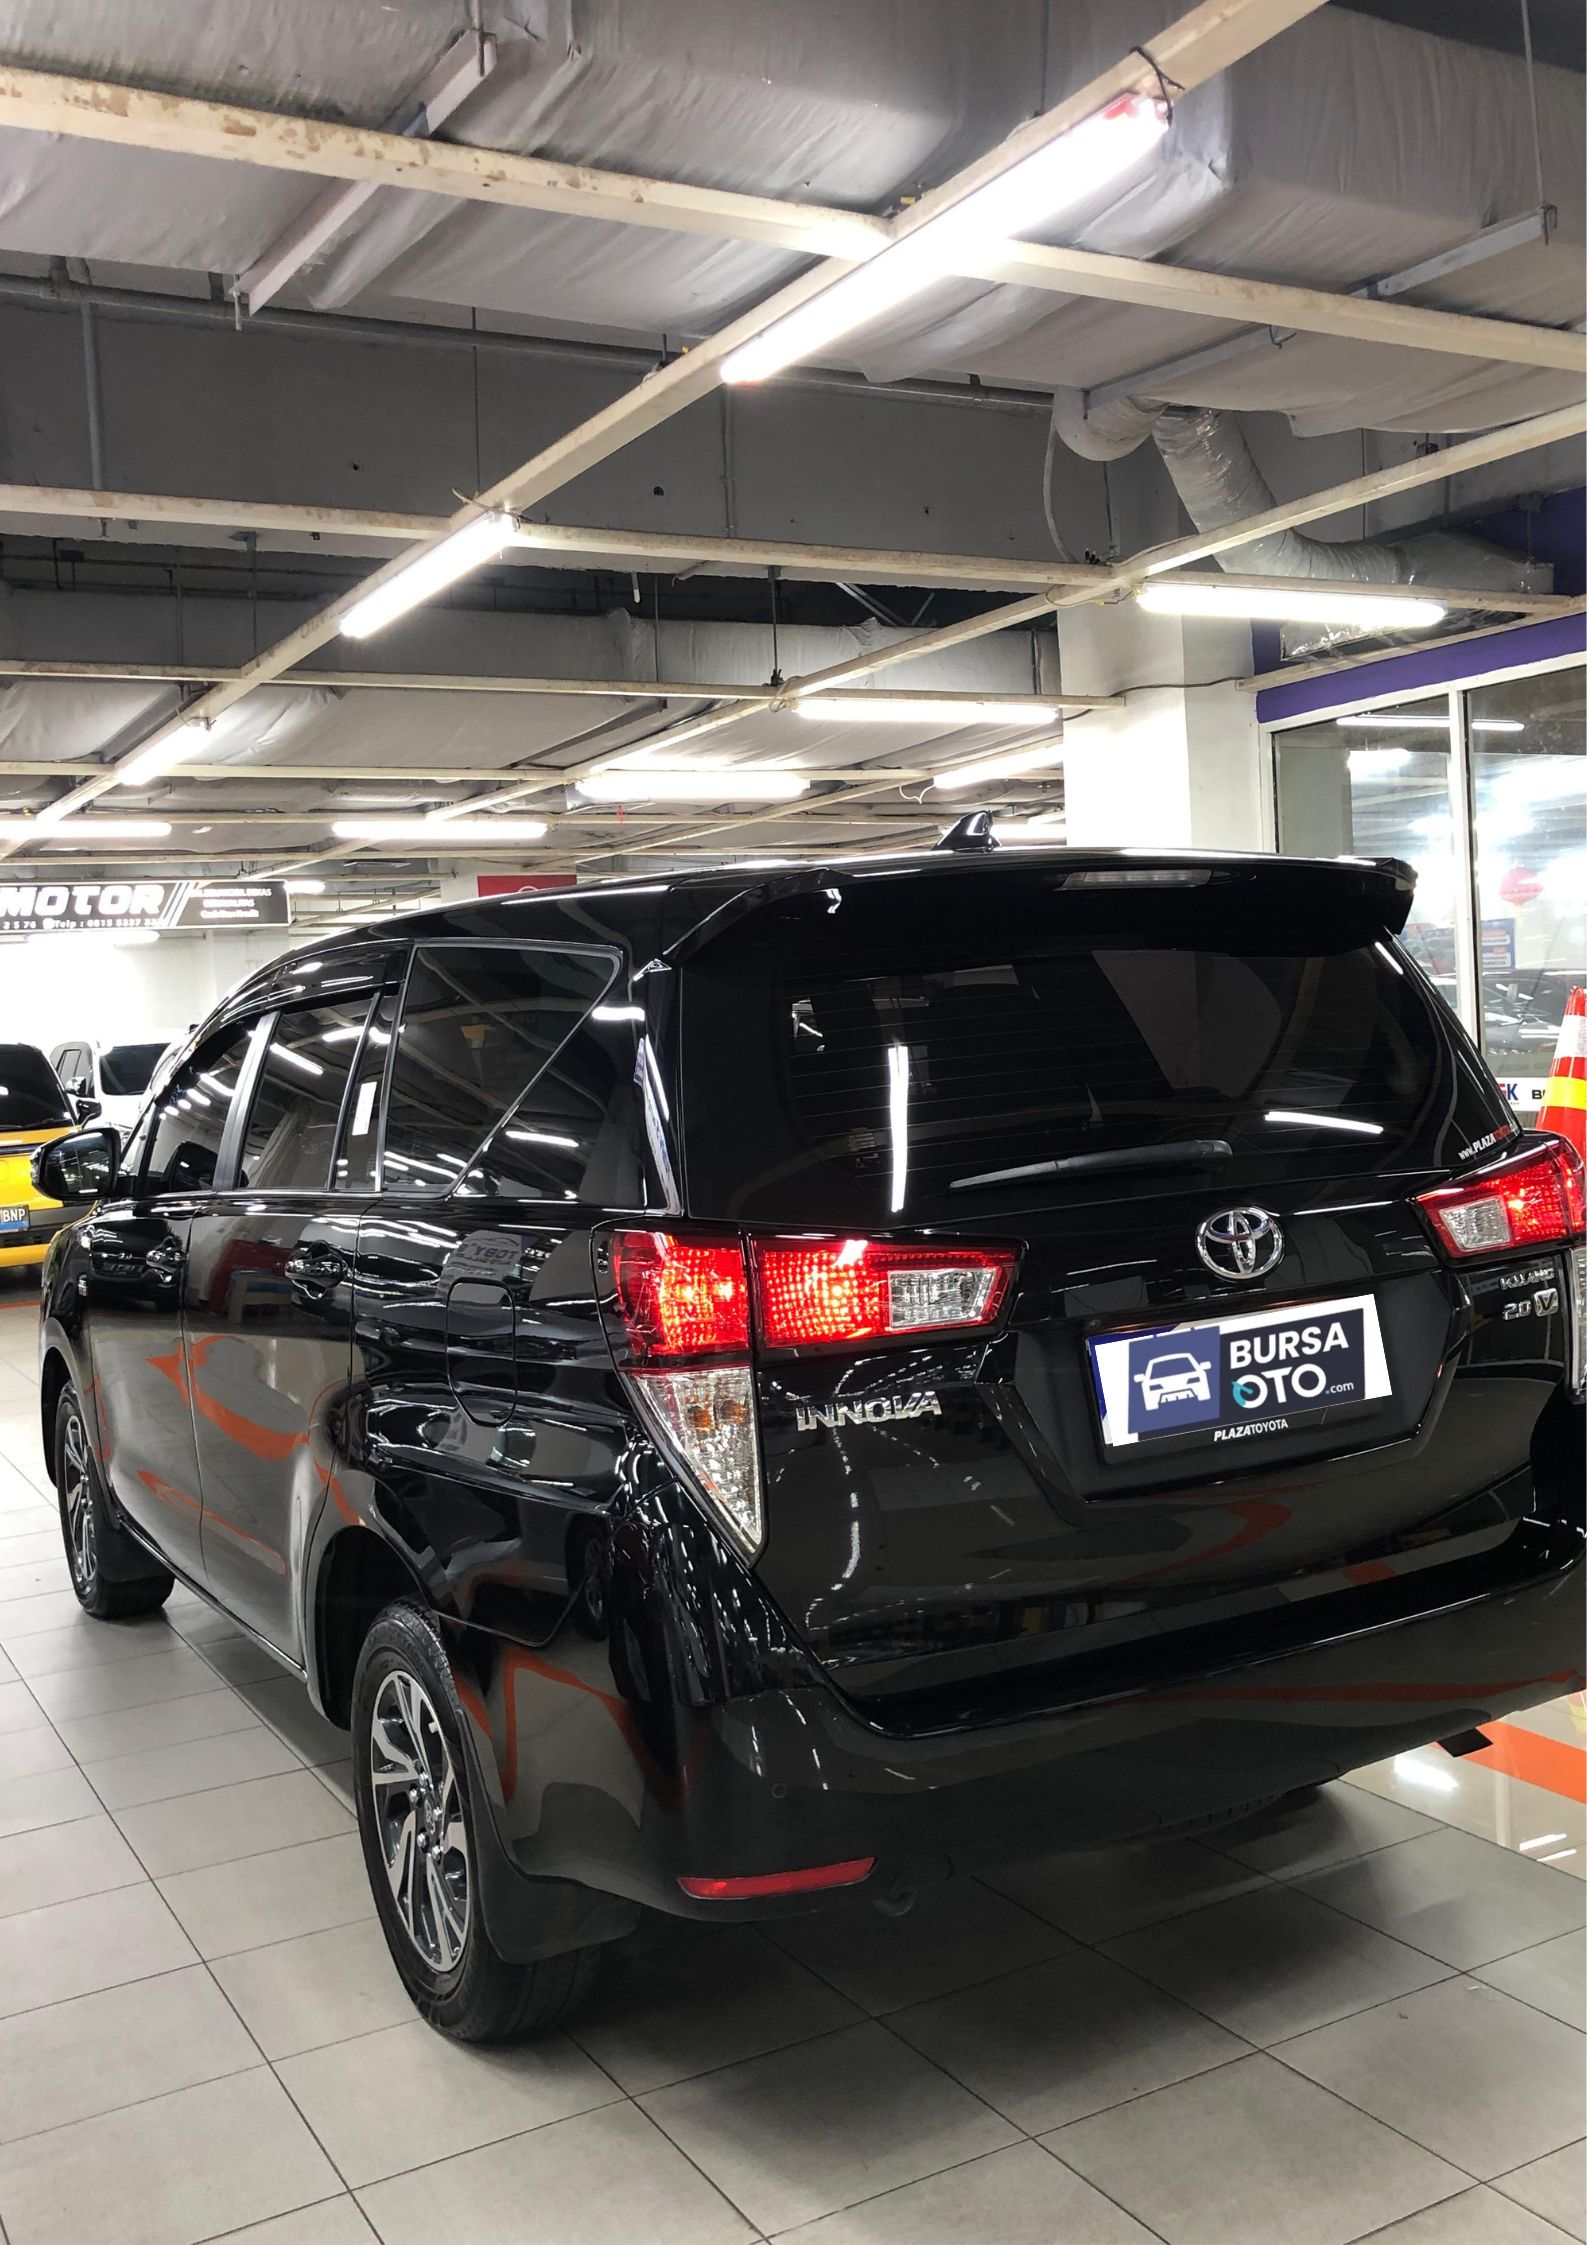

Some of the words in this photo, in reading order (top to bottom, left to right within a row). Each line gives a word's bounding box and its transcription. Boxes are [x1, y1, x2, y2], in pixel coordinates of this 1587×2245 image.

[0, 884, 165, 917] MOTOR
[1532, 1089, 1546, 1100] B
[795, 1391, 942, 1431] INNOVA
